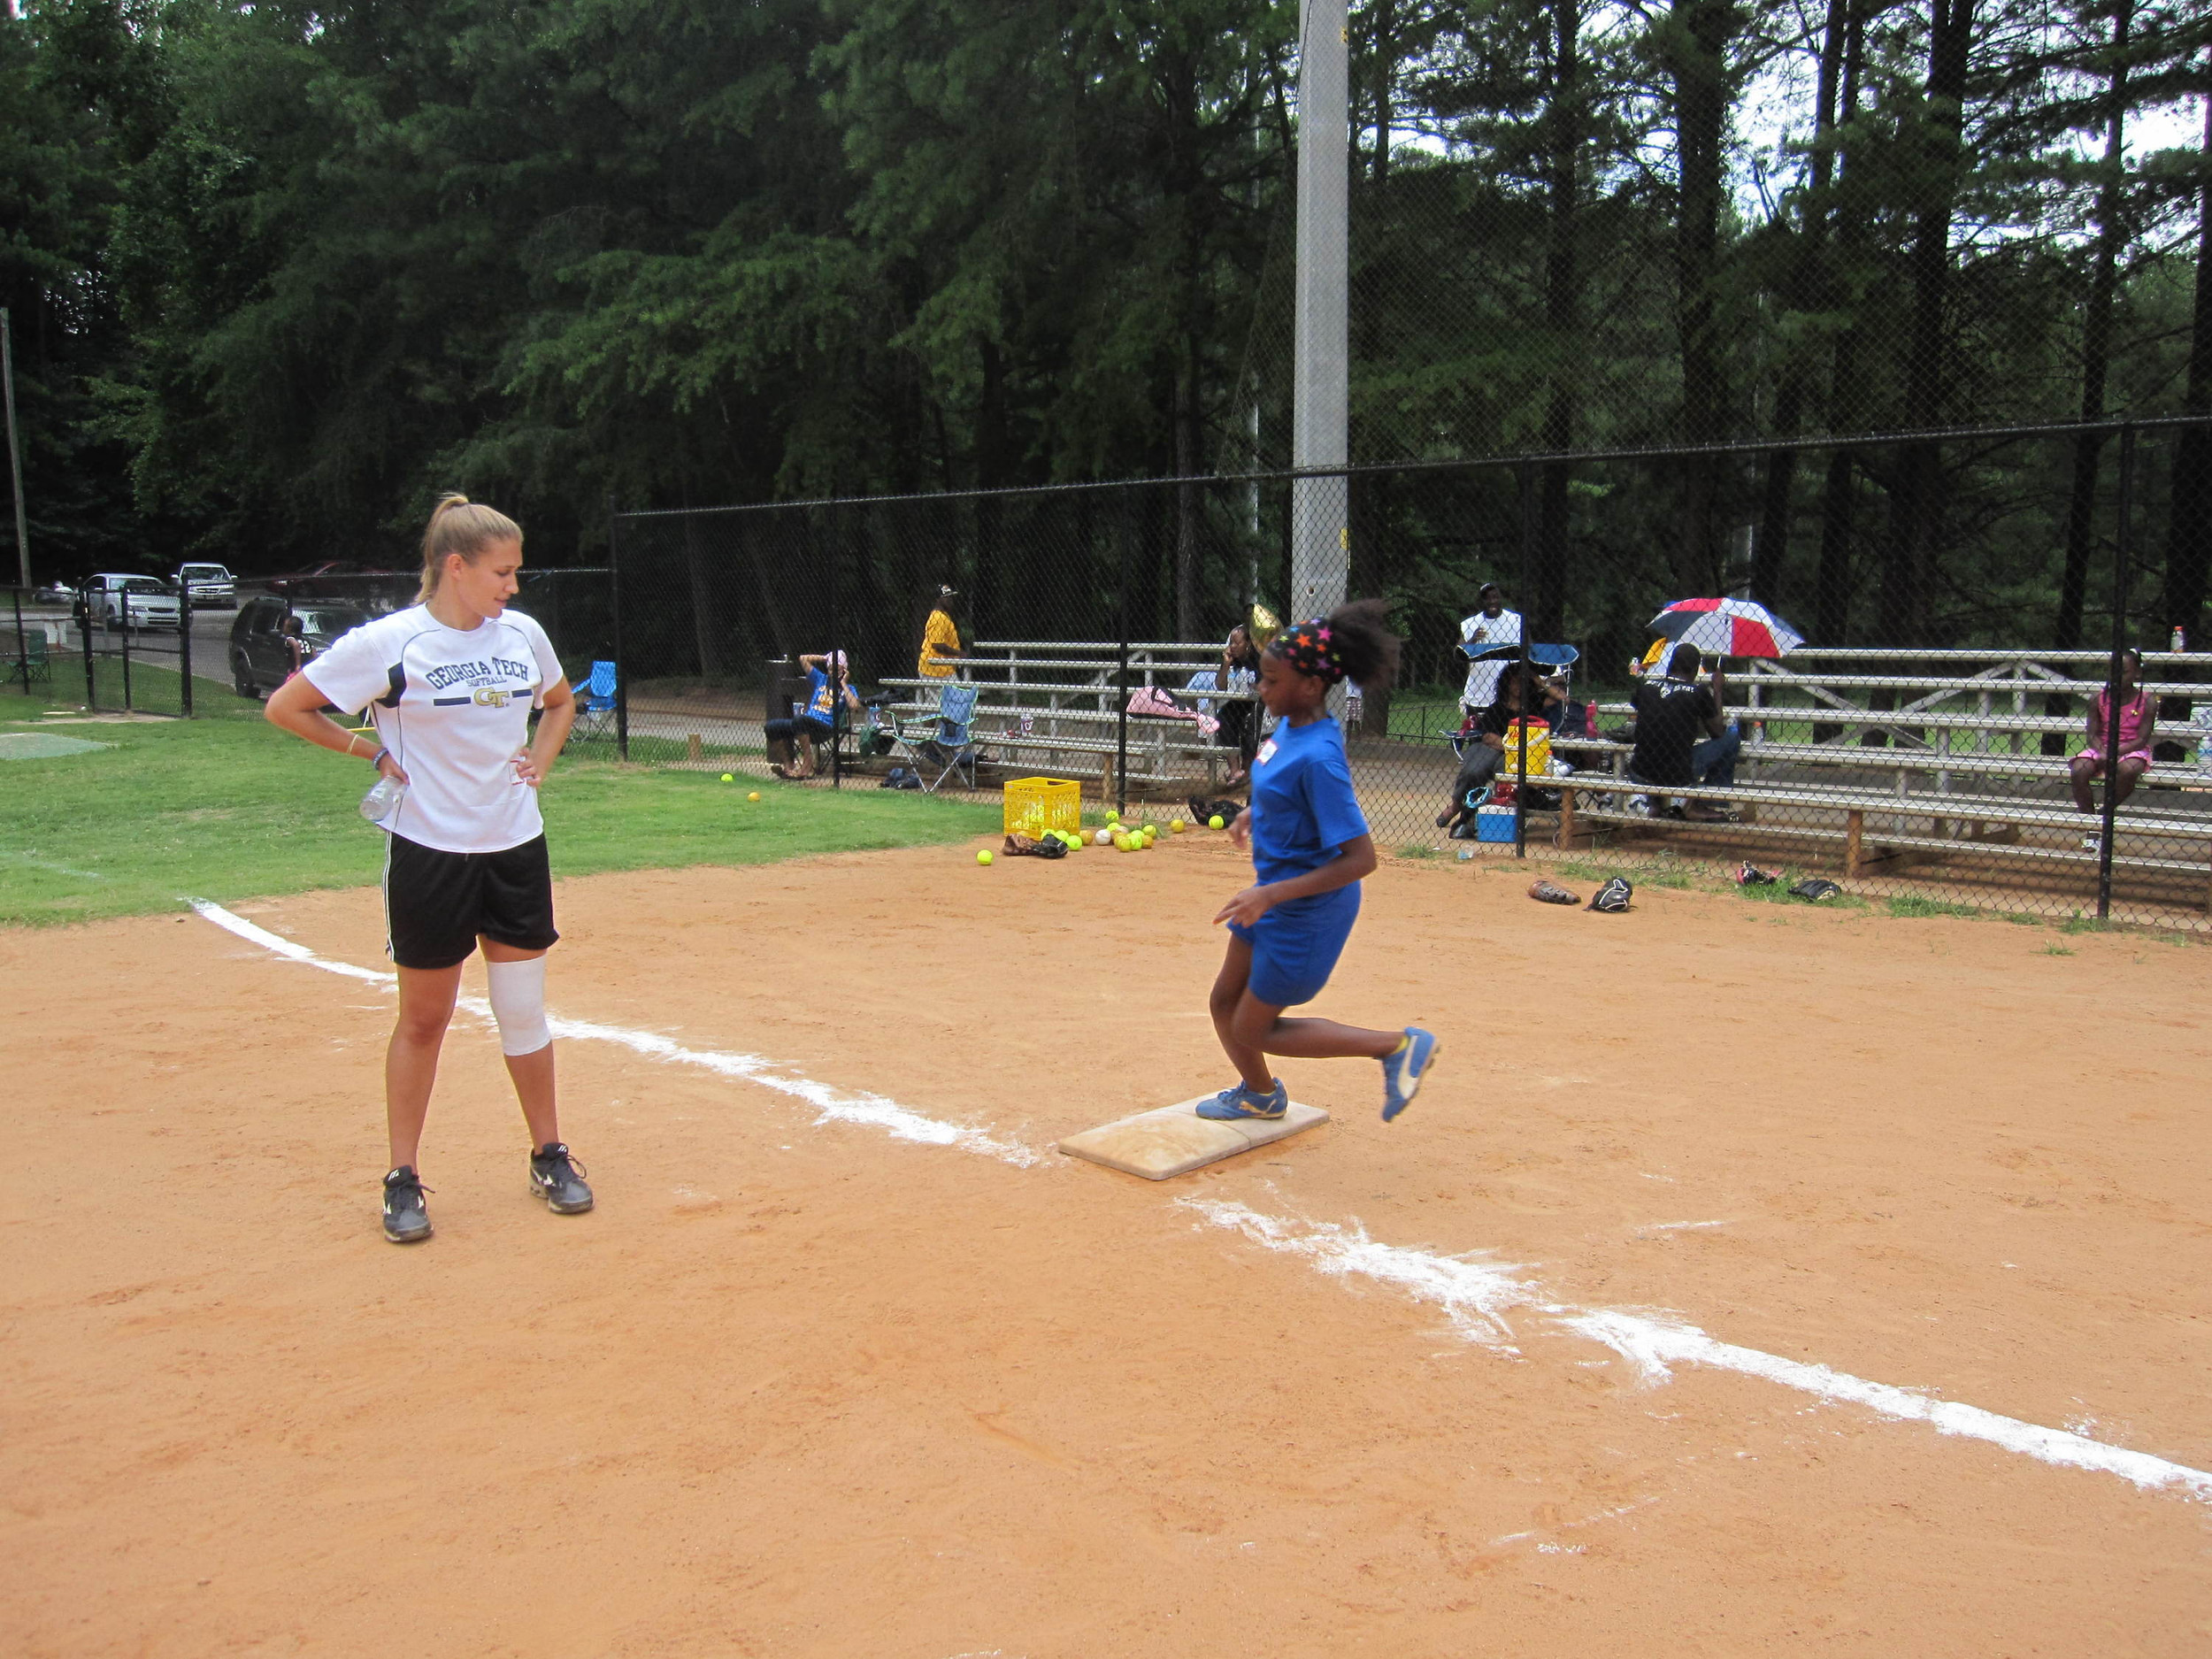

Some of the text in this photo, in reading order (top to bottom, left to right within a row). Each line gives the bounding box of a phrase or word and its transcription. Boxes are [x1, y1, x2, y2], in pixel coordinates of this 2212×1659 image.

[426, 656, 529, 690] GEORGIA TECH
[465, 676, 508, 687] SOFTBALL
[473, 687, 510, 708] GT
